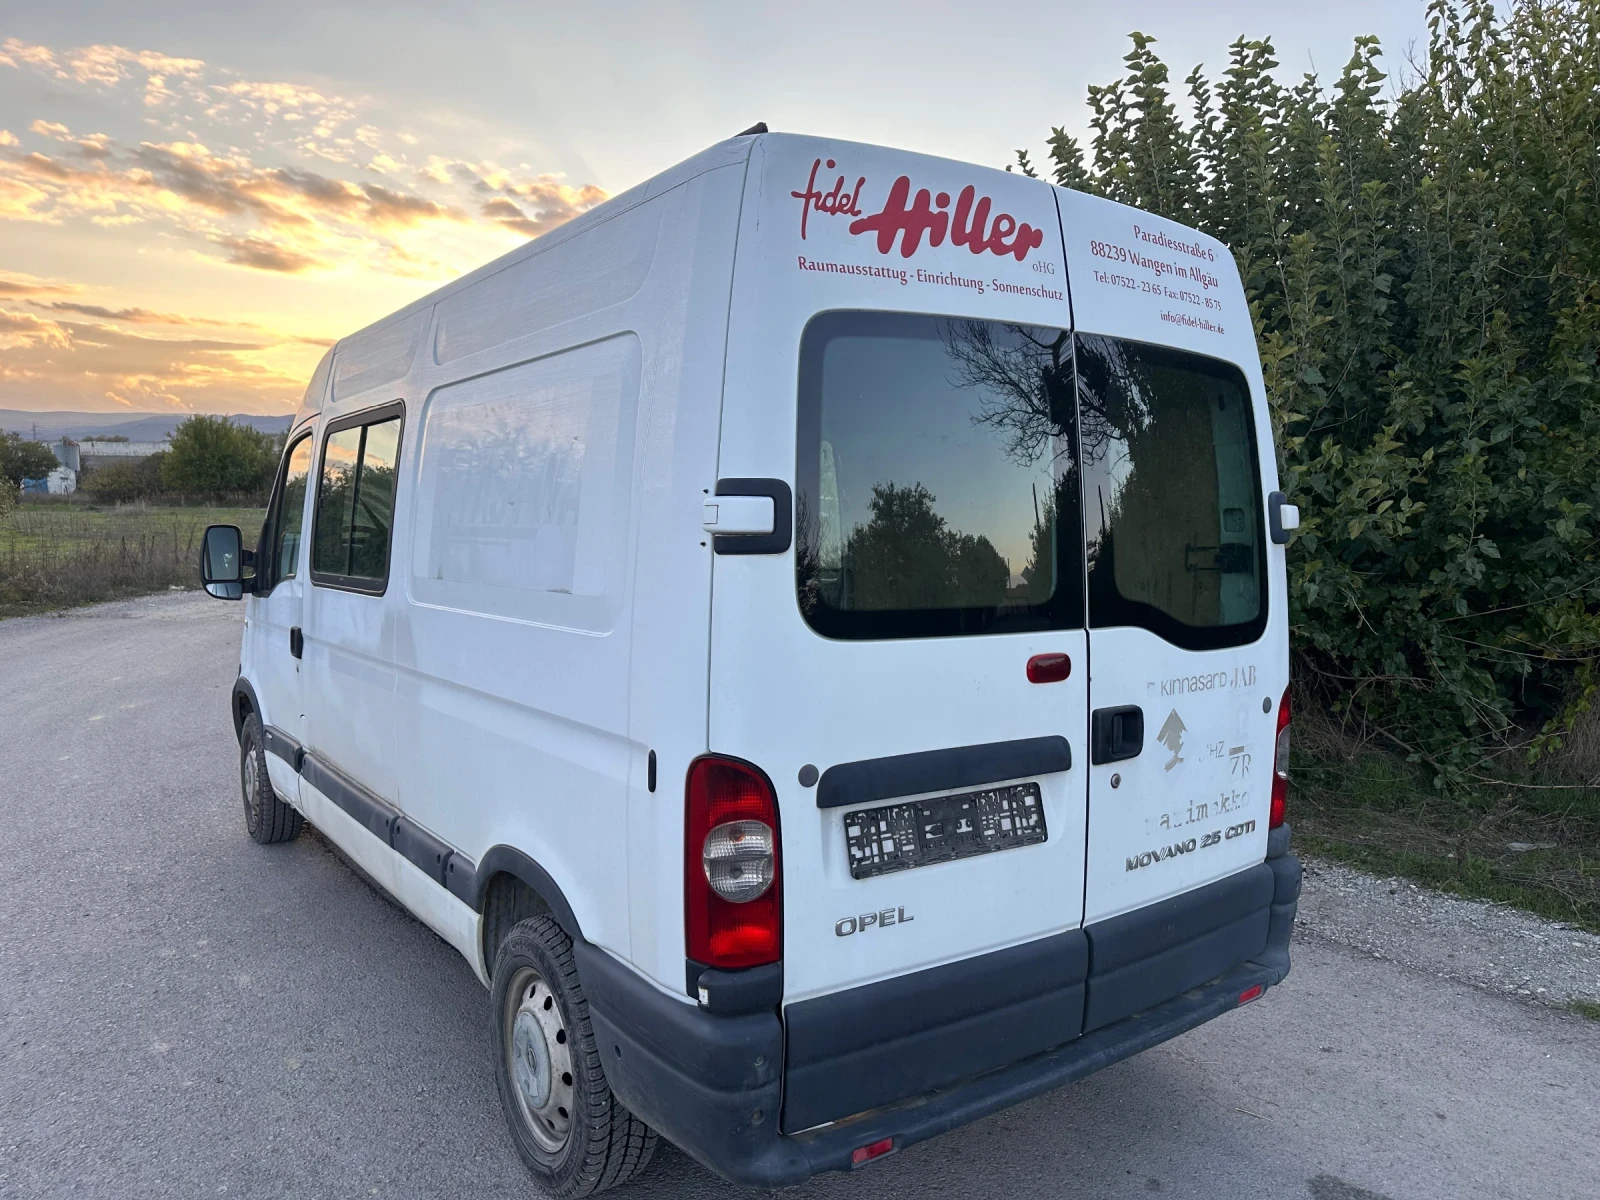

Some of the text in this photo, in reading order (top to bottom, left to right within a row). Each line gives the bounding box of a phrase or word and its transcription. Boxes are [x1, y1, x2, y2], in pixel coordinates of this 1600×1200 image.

[791, 158, 1043, 262] fidel Hiller
[1134, 224, 1214, 262] Paradiesstraße 6
[798, 256, 908, 285] Raumausstattug
[916, 268, 984, 294] Einrichtung
[992, 279, 1064, 301] Sonnenschutz
[1032, 261, 1055, 275] oHG
[1090, 240, 1219, 289] 88239 Wangen im Allgäu
[1110, 275, 1136, 290] 07522
[1179, 290, 1201, 305] 07522
[1160, 310, 1225, 335] info@fidel-hiller.de
[1230, 665, 1256, 691] JAB
[1125, 836, 1197, 872] MOVANO
[835, 905, 915, 937] OPEL
